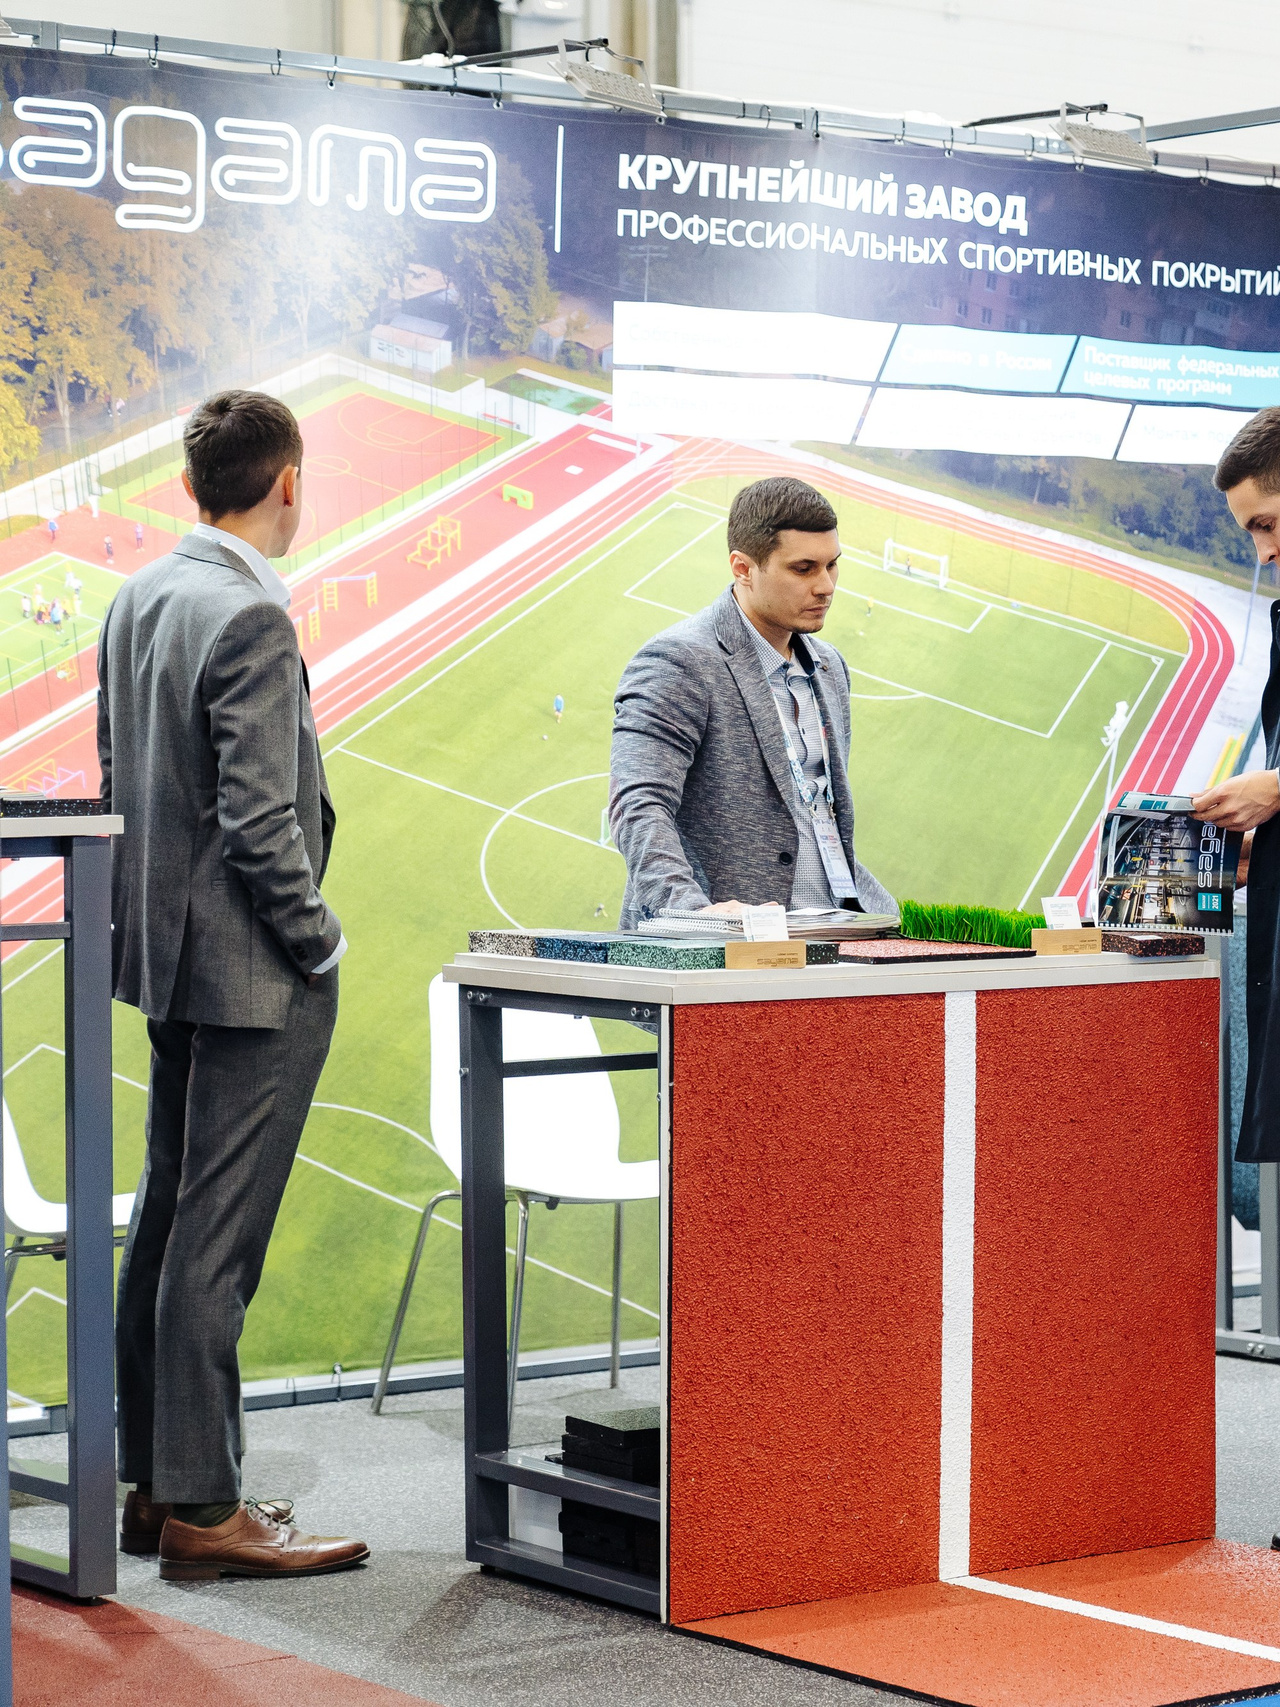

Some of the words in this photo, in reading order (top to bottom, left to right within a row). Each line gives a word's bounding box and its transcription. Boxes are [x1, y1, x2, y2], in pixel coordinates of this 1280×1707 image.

[0, 96, 498, 233] agama
[617, 153, 898, 217] КРУПНЕЙШИЙ
[904, 183, 1029, 236] ЗАВОД
[616, 208, 949, 264] ПРОФЕССИОНАЛЬНЫХ
[958, 241, 1142, 285] СПОРТИВНЫХ
[995, 351, 1053, 372] России
[1084, 346, 1171, 372] Поставщик
[1177, 354, 1280, 379] федеральных
[1083, 370, 1151, 392] целевых
[1157, 376, 1233, 397] программ
[1198, 820, 1221, 888] saga
[1211, 895, 1219, 910] 2021
[756, 957, 799, 968] sagama
